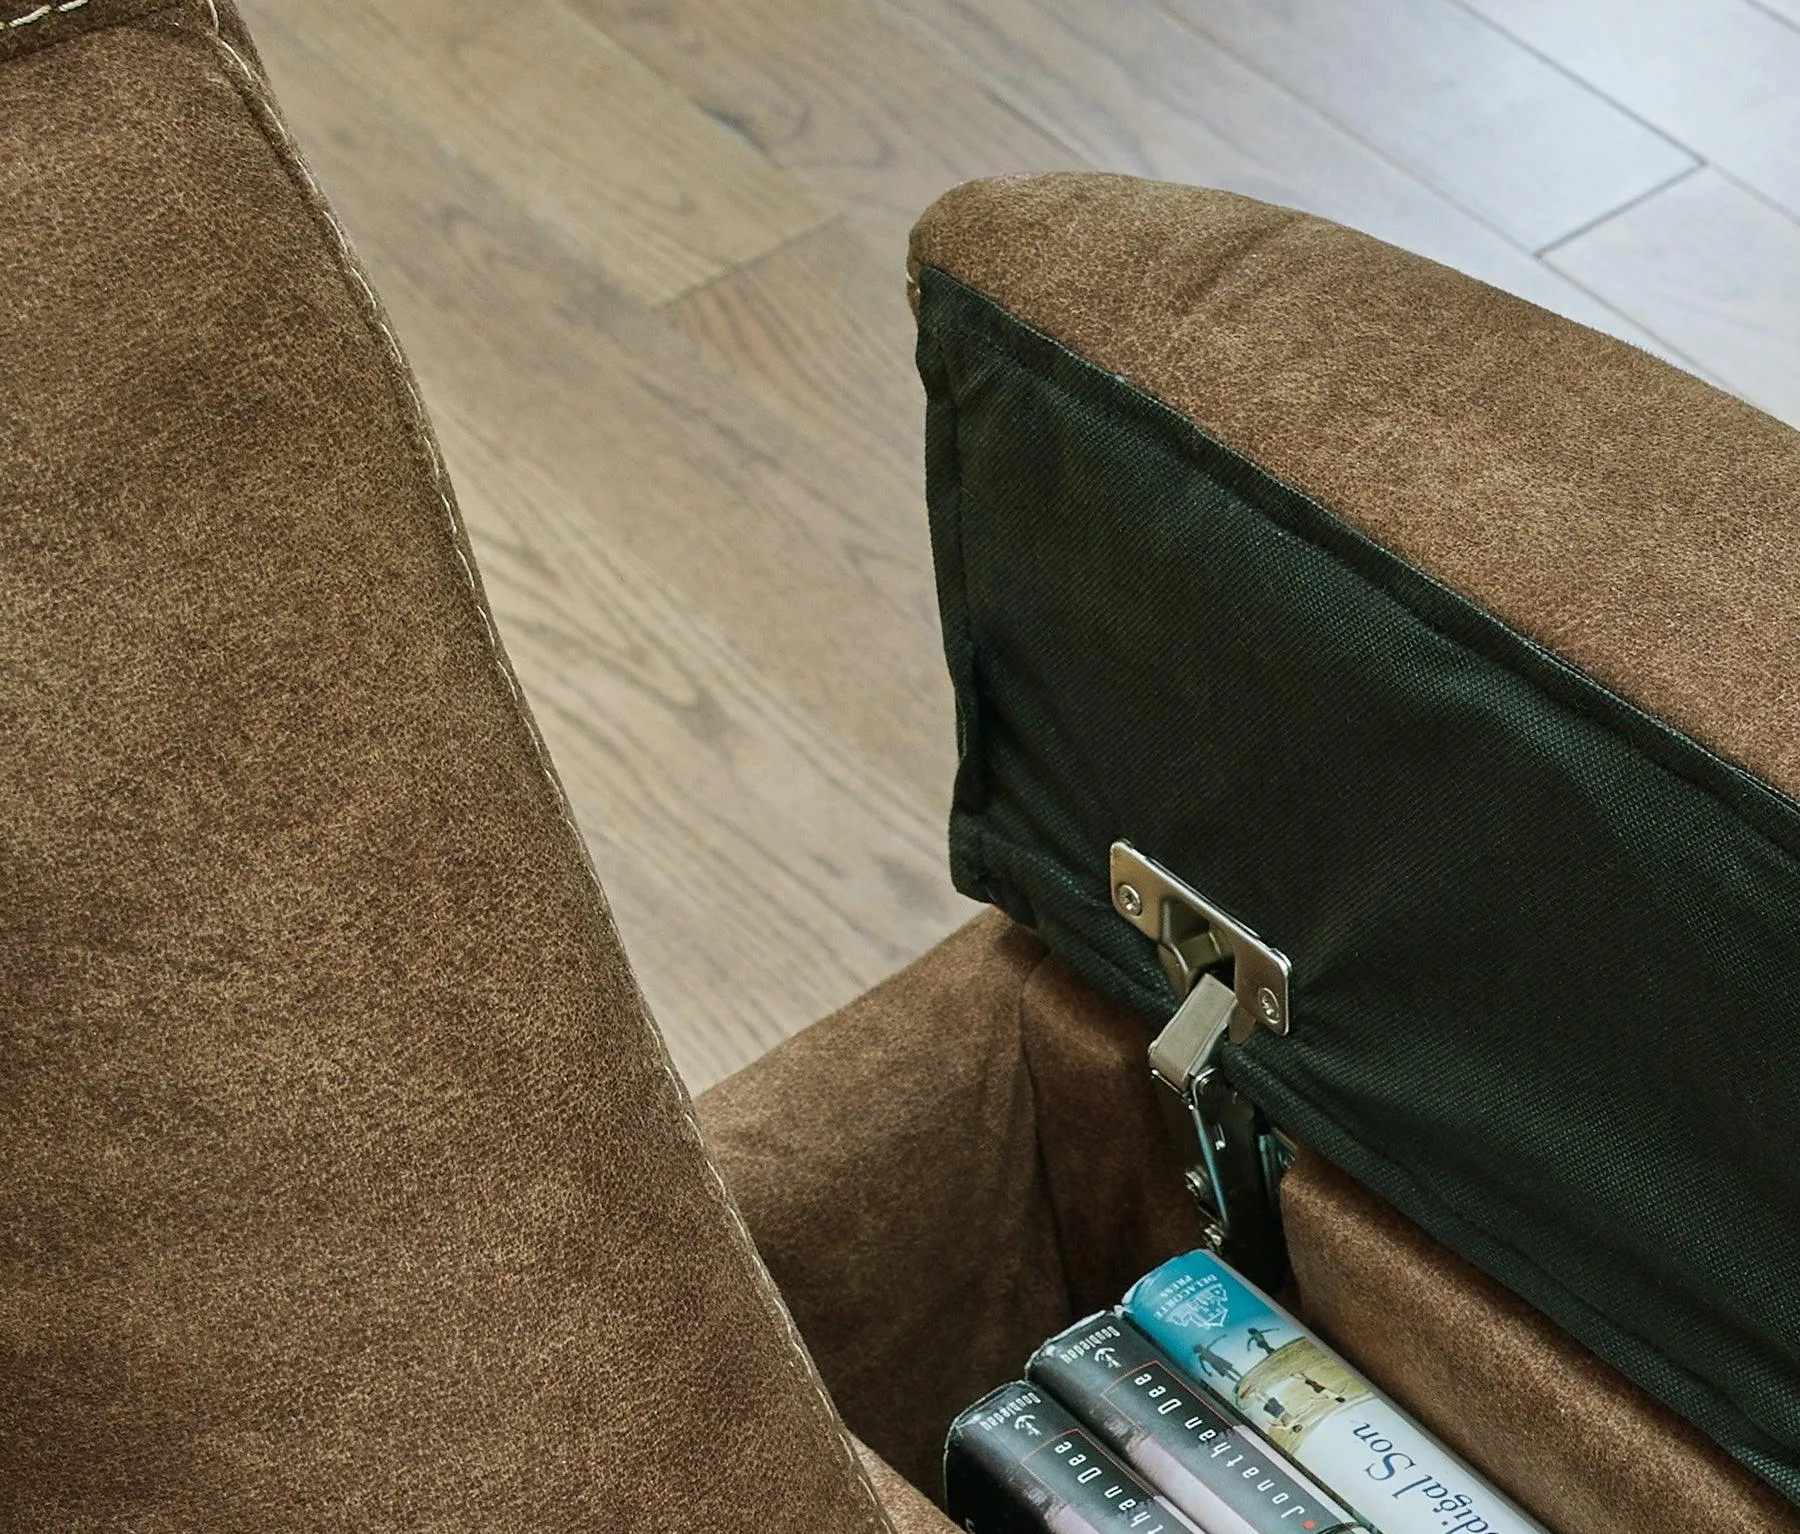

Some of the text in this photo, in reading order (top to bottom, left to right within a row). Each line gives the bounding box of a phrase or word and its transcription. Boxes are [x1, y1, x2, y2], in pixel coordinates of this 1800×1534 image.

[1154, 1273, 1218, 1319] DELACORTE
[1160, 1274, 1193, 1298] PRESS
[1060, 1325, 1122, 1364] Doubleday
[980, 1391, 1042, 1432] Doubleday
[1054, 1441, 1102, 1484] Dee
[1134, 1373, 1305, 1519] Jonathan Dee
[1352, 1421, 1416, 1482] Son
